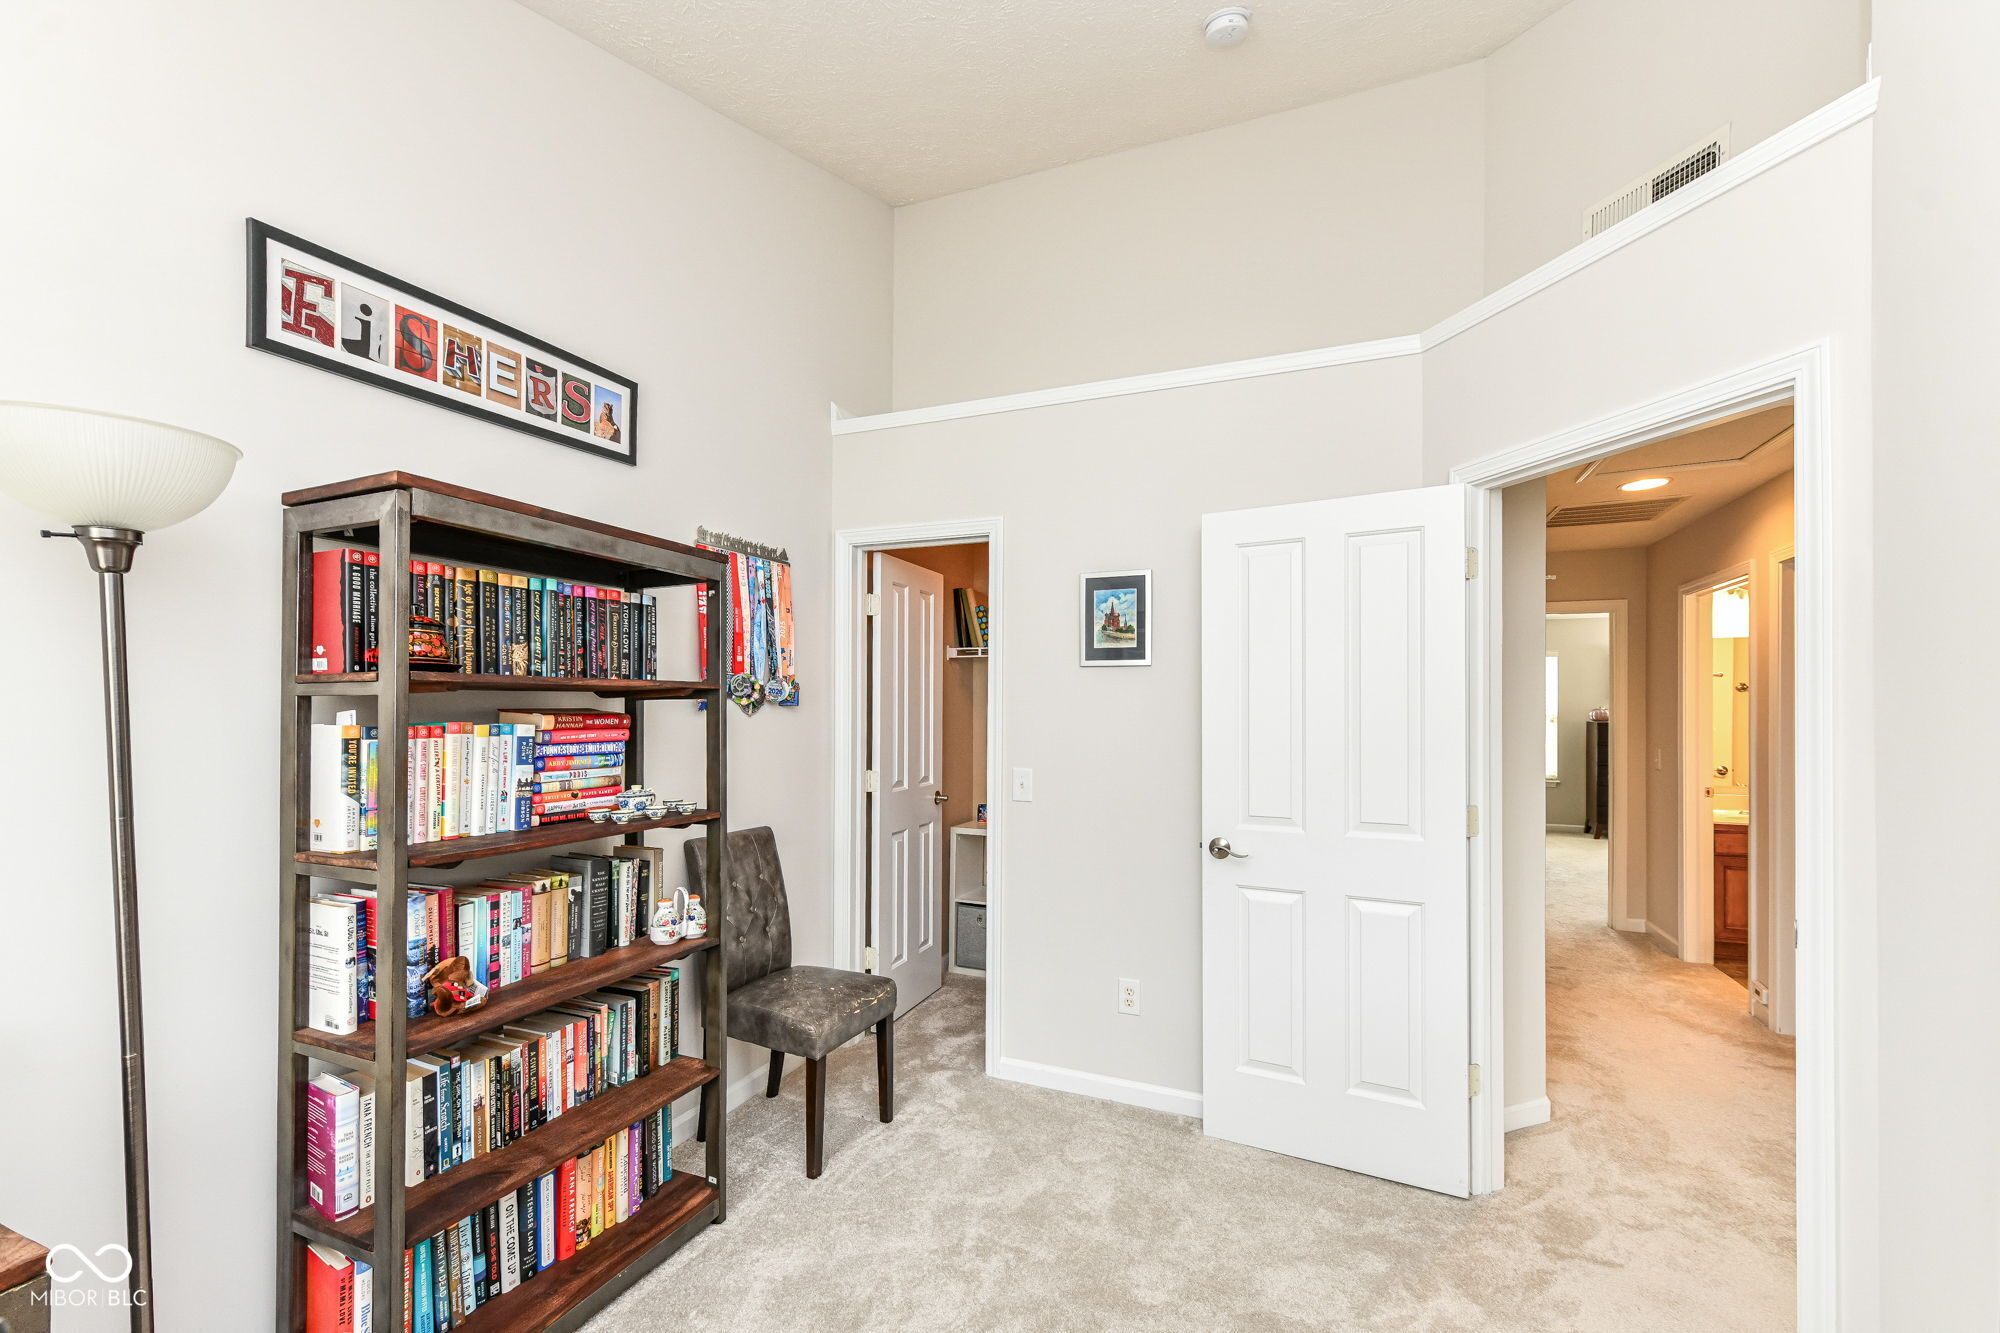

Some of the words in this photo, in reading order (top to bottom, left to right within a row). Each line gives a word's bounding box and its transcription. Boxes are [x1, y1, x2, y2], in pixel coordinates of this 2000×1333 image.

[353, 592, 361, 623] MARRIAGE
[369, 581, 377, 612] collective
[465, 606, 473, 618] Vice
[349, 740, 357, 764] YOU'RE
[348, 767, 357, 794] INVITED
[440, 1072, 449, 1088] Life
[364, 1098, 372, 1117] TANA
[456, 1100, 461, 1108] ON
[440, 1103, 450, 1131] Scratch
[364, 1119, 372, 1148] FRENCH
[506, 1204, 513, 1218] ON
[506, 1219, 514, 1236] THE
[450, 1230, 460, 1281] INDEPENDENCE
[507, 1237, 516, 1262] COME
[508, 1264, 516, 1274] UP
[361, 1304, 371, 1328] Blue
